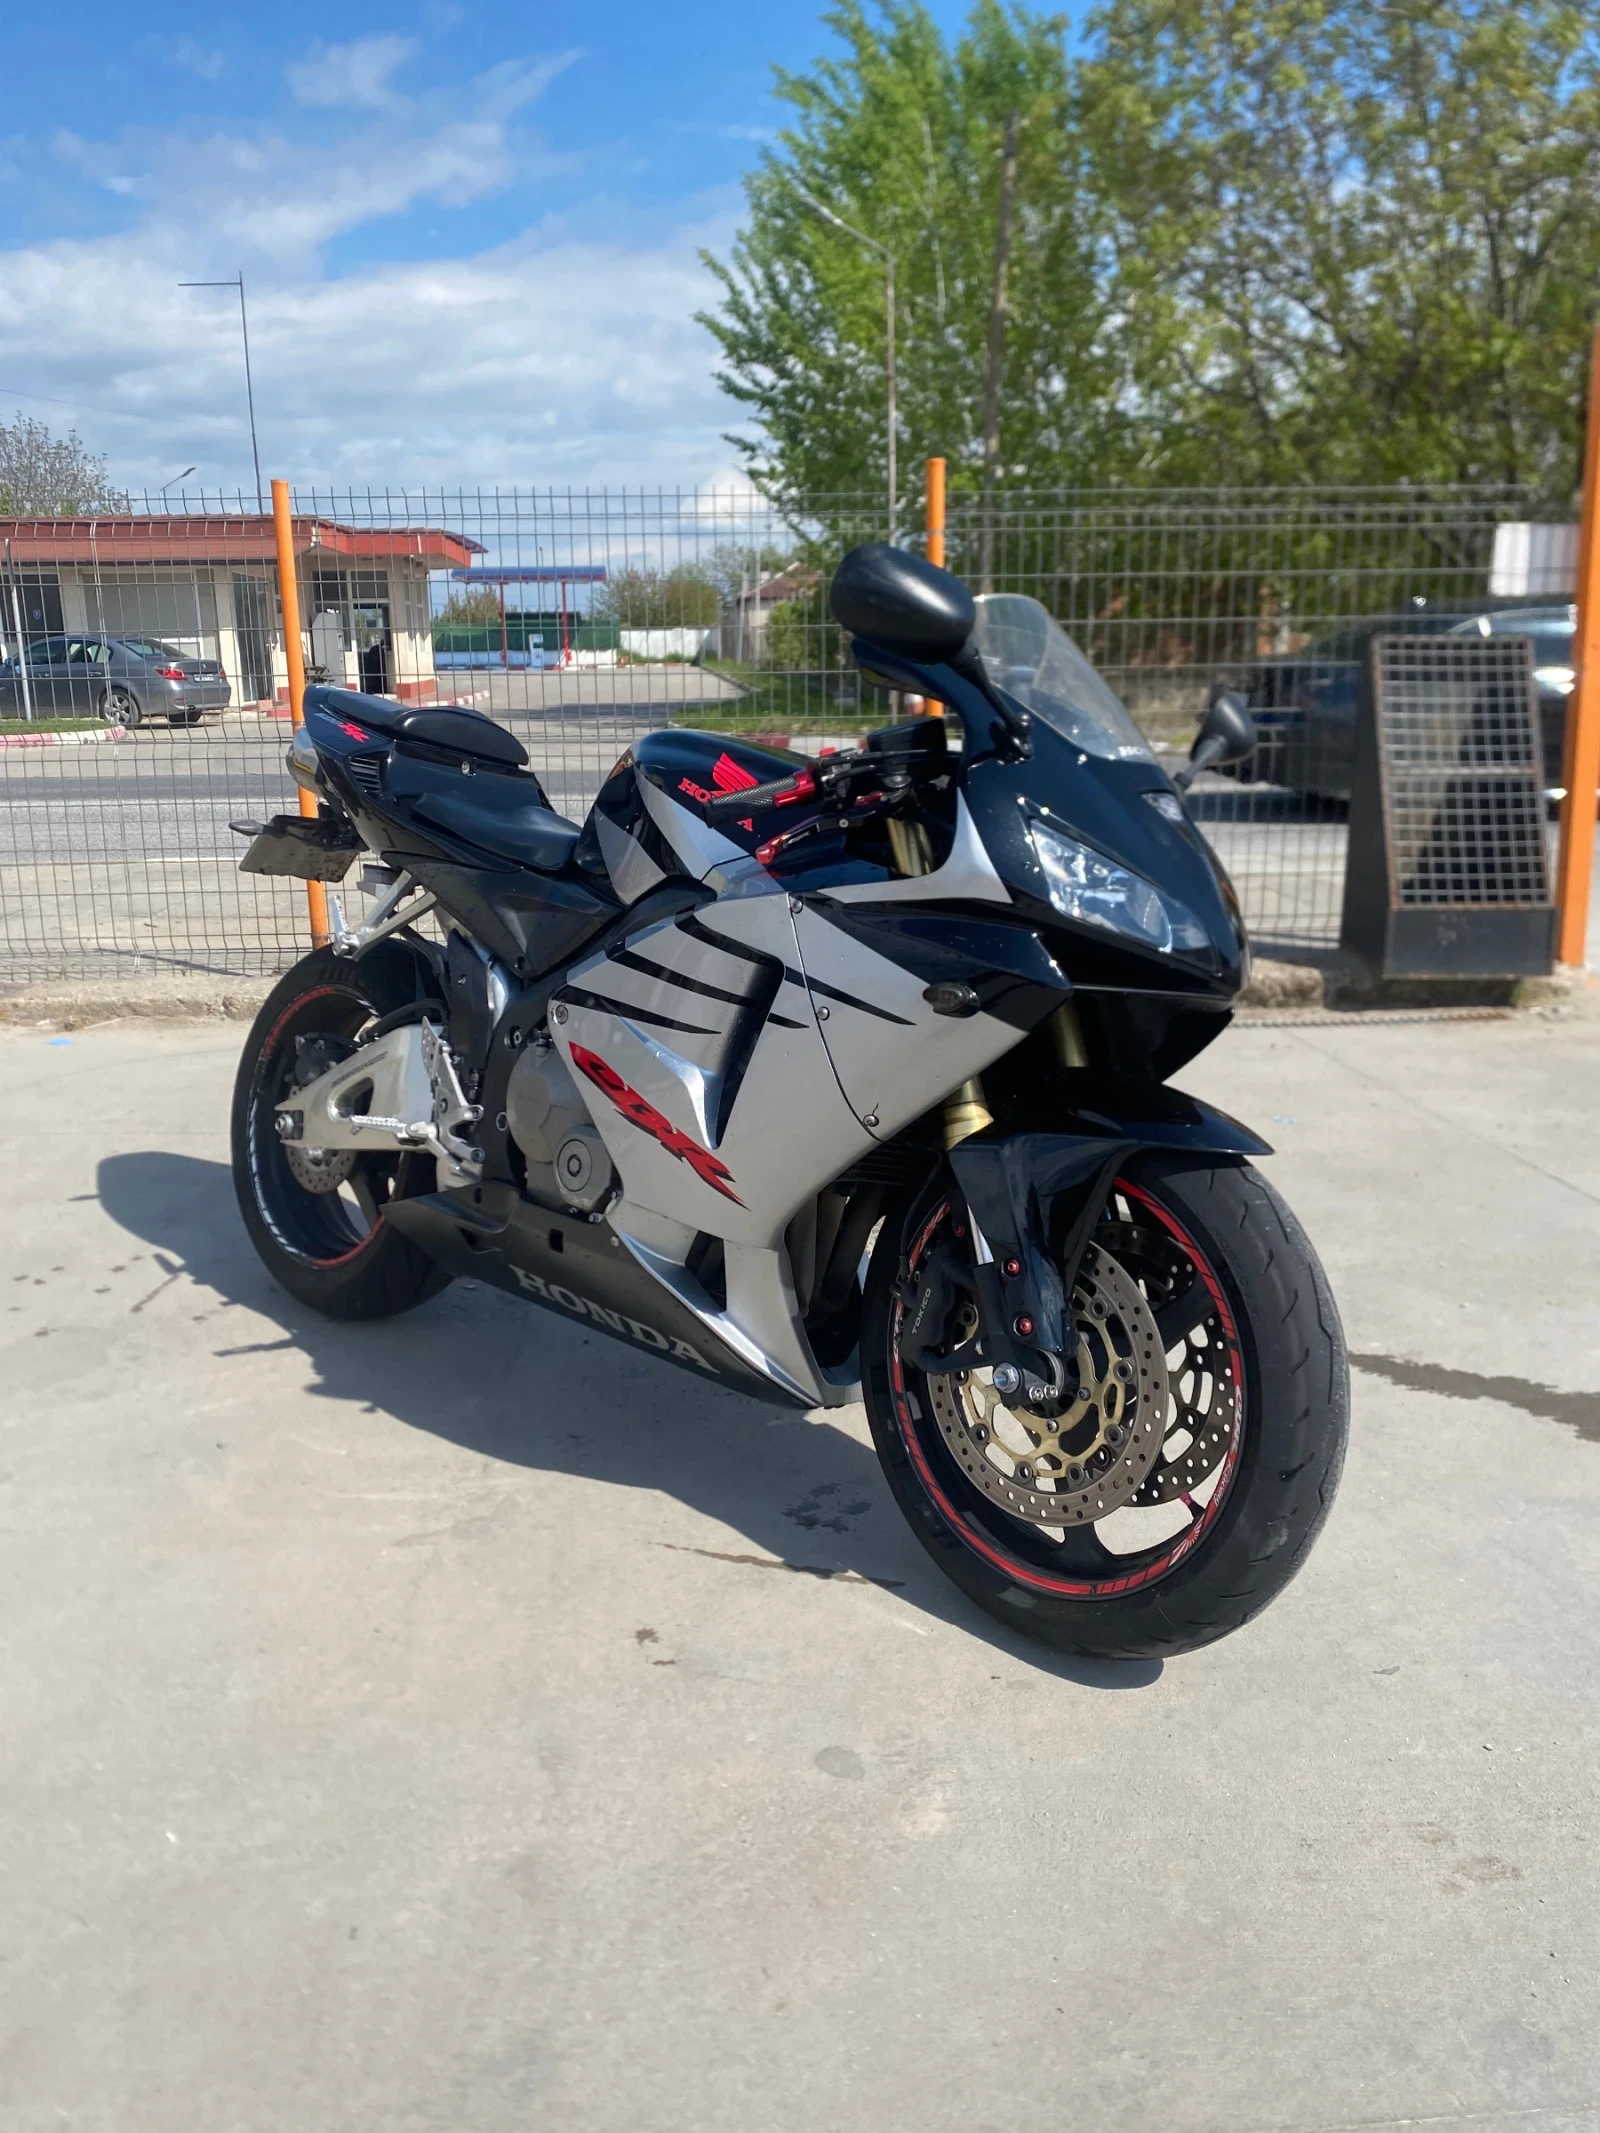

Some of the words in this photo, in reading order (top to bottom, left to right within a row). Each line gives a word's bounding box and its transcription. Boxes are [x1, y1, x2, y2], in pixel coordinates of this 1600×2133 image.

[677, 777, 753, 832] HOA
[568, 1041, 751, 1211] CBR
[508, 1263, 721, 1374] HONDA
[911, 1287, 932, 1334] TOKICO
